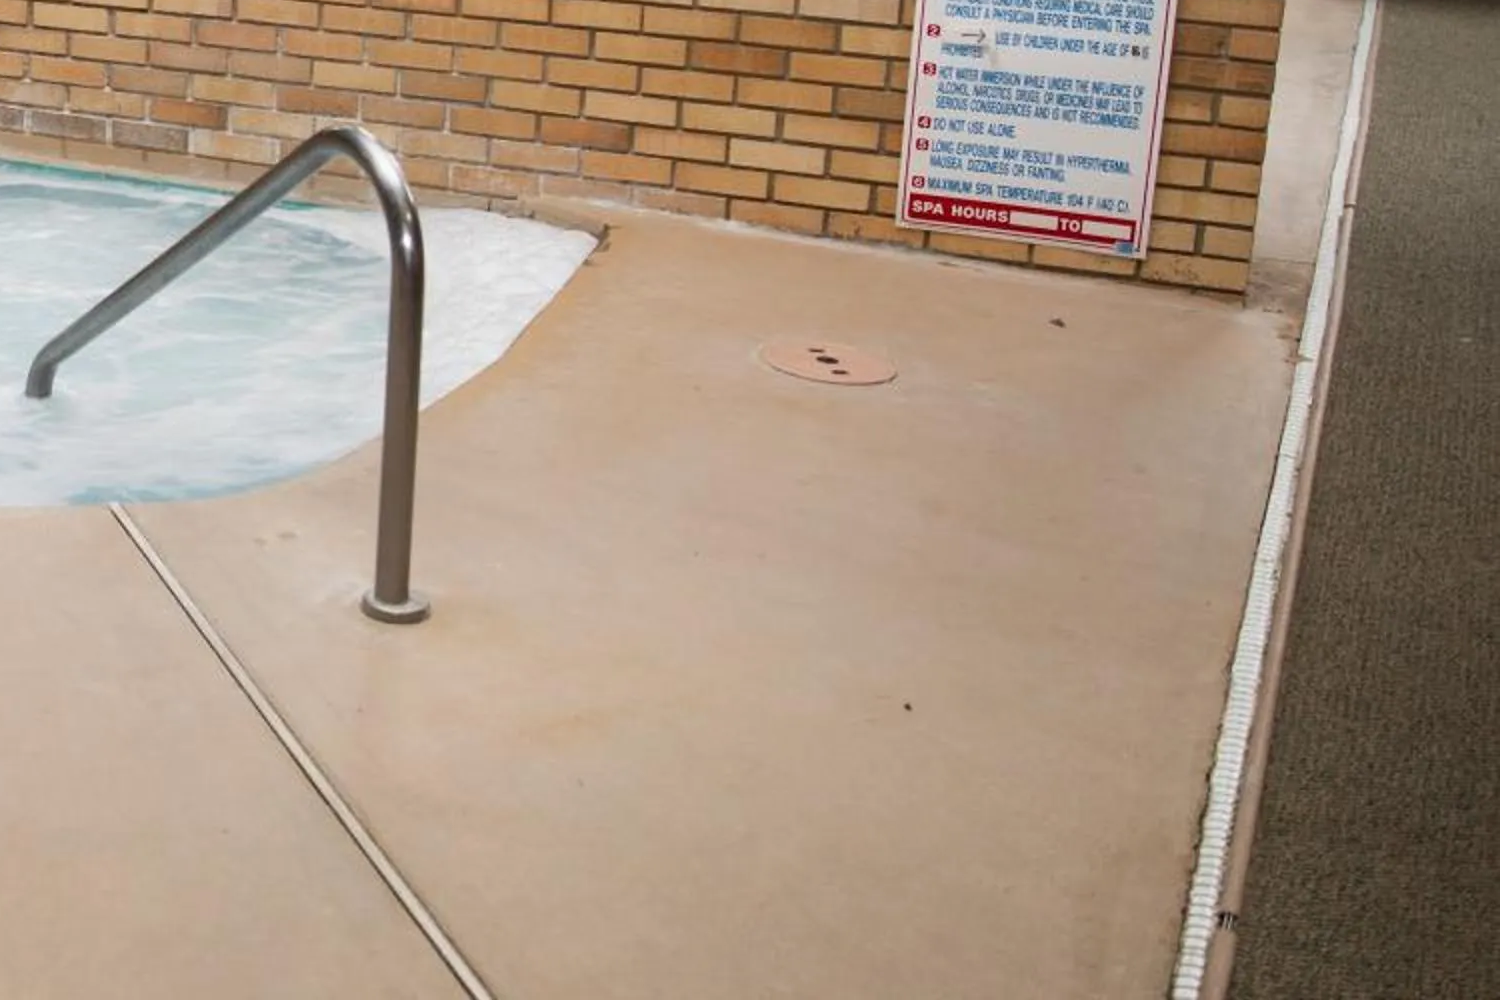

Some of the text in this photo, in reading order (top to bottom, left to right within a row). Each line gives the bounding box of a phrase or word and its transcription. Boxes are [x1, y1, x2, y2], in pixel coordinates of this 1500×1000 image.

[1104, 2, 1123, 17] CARE
[1125, 4, 1154, 20] SHOULD
[1035, 11, 1069, 27] BEFORE
[1113, 18, 1131, 33] THE
[1102, 41, 1118, 56] AGE
[1118, 43, 1130, 57] OF
[1132, 85, 1145, 99] OF
[969, 97, 1032, 118] CONSEQUENCES
[1033, 104, 1050, 120] AND
[1132, 100, 1144, 115] TO
[932, 116, 946, 130] DO
[948, 118, 965, 132] NOT
[966, 120, 985, 135] USE
[955, 141, 1002, 159] EXPOSURE
[965, 157, 1010, 176] DIZZINESS
[1012, 163, 1025, 178] OR
[927, 176, 973, 194] MAXIMUM
[974, 182, 993, 196] SPA
[995, 184, 1063, 205] TEMPERATURE
[911, 198, 1082, 234] SPA HOURS TO
